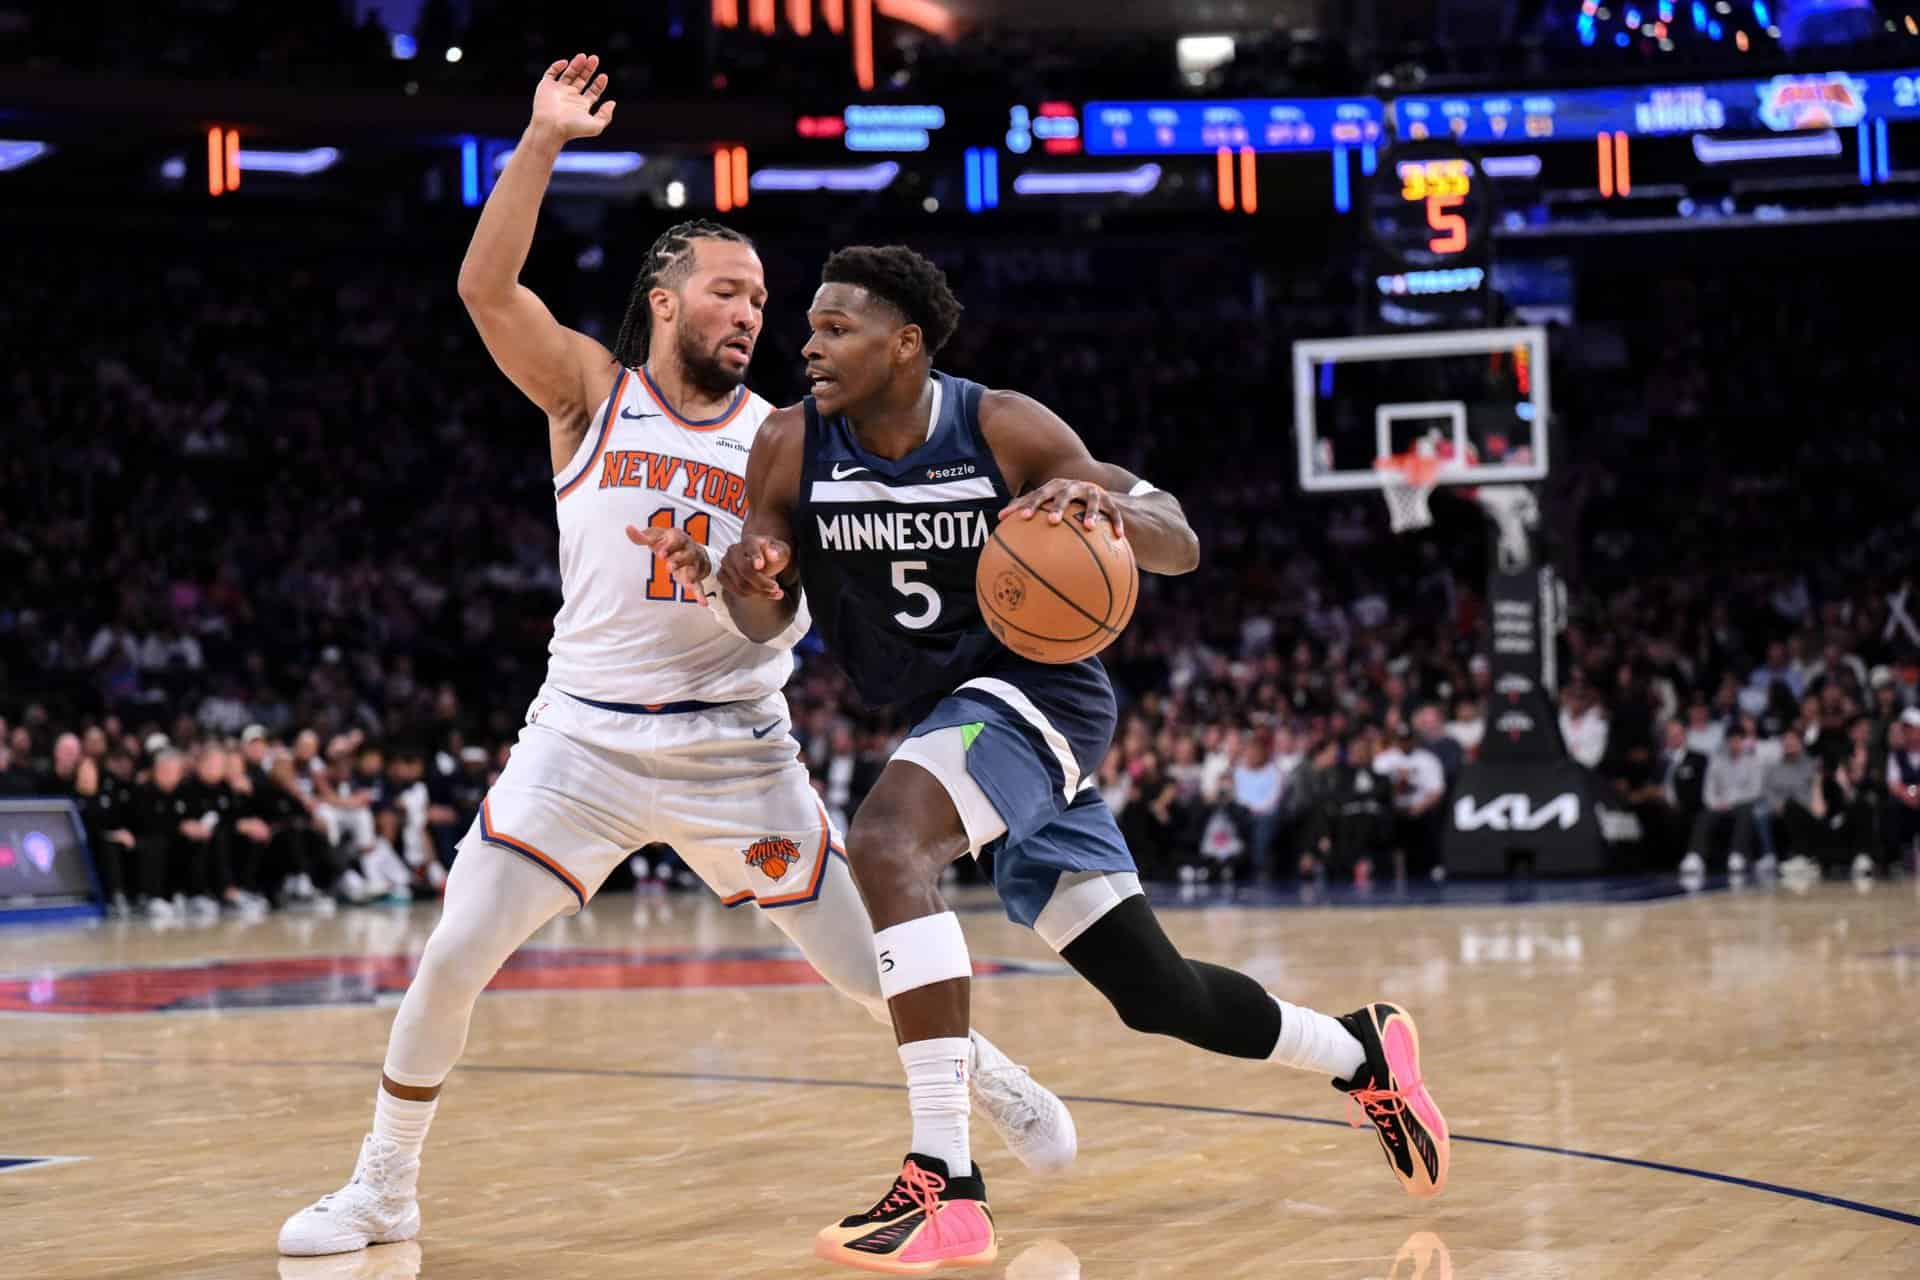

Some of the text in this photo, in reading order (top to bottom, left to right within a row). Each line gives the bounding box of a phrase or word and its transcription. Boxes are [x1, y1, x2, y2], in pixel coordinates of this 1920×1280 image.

[1426, 193, 1467, 254] 5
[599, 450, 750, 520] NEW YOR
[935, 464, 976, 479] sezzle
[816, 509, 990, 551] MINNESOTA
[891, 560, 942, 630] 5
[745, 838, 801, 865] KNICKS
